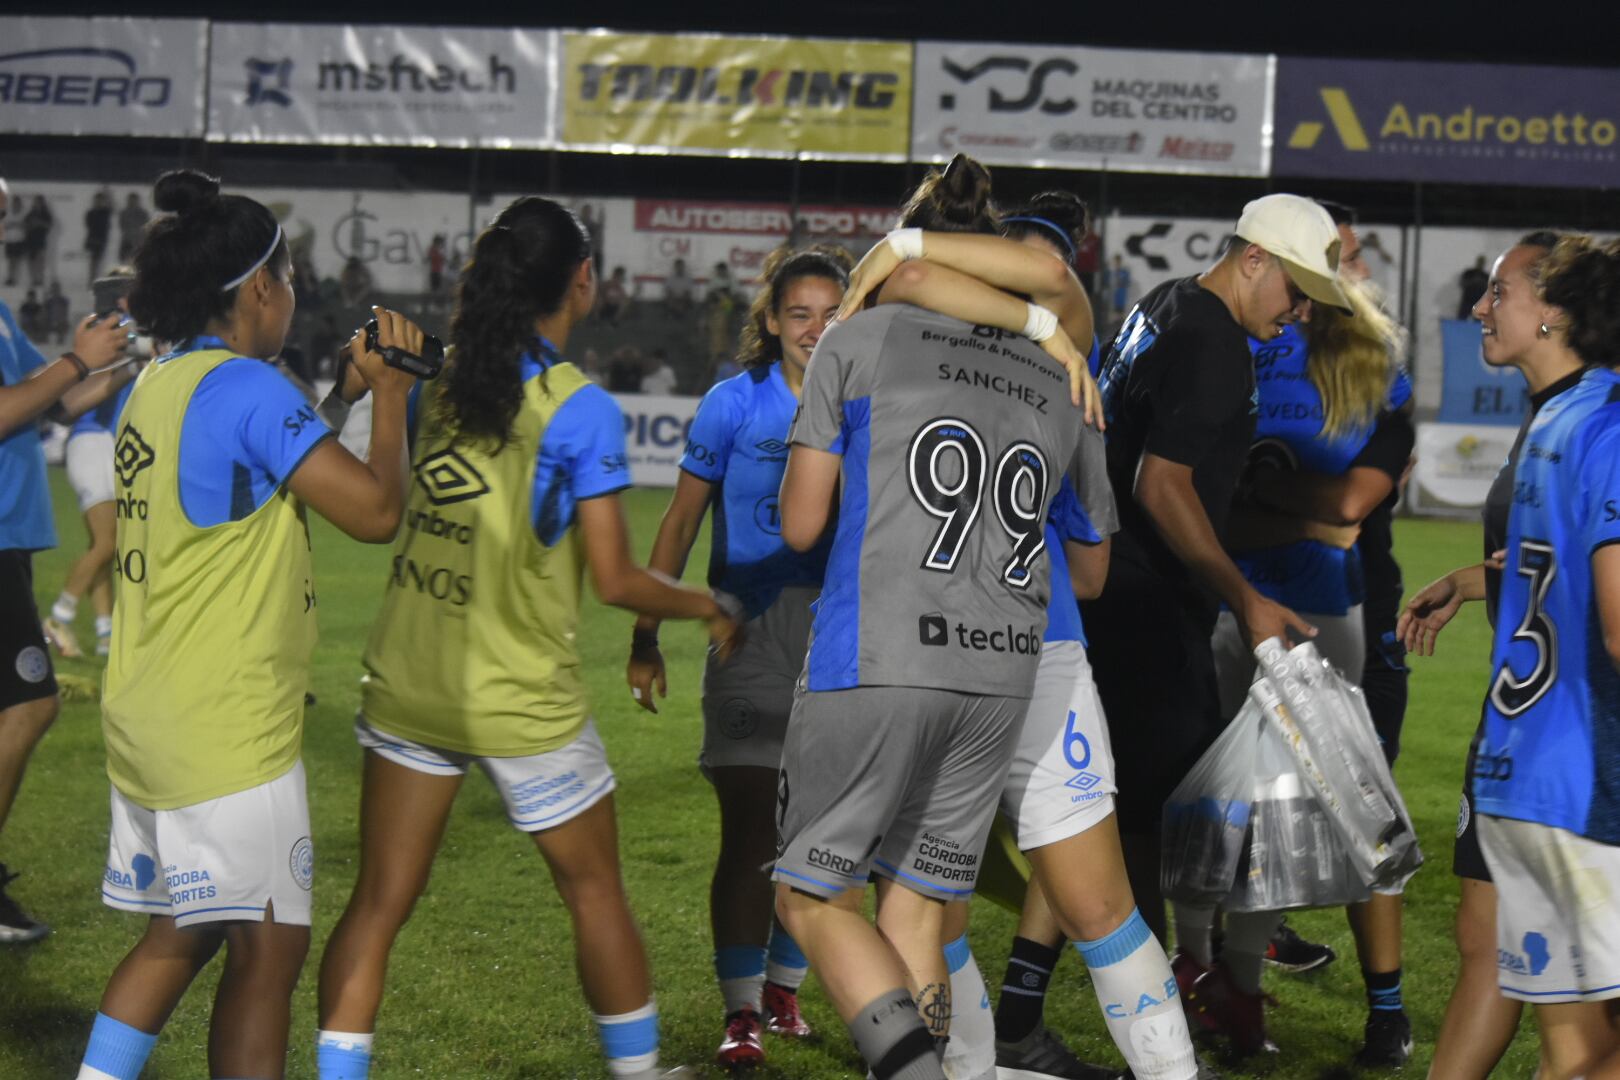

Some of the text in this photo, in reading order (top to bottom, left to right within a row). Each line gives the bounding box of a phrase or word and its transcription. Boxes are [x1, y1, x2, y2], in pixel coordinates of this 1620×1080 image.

[1091, 79, 1220, 101] MAQUINAS
[1091, 100, 1238, 124] DEL CENTRO
[1380, 103, 1617, 146] Androetto
[921, 330, 1063, 383] Bergallo & Pastrone
[938, 363, 1049, 415] SANCHEZ
[906, 416, 1048, 590] 99
[1604, 499, 1620, 523] S
[954, 623, 1040, 656] teclab
[1490, 540, 1559, 719] 3
[1063, 710, 1090, 770] 6
[1071, 791, 1103, 803] umbro
[918, 842, 977, 866] CÓRDOBA
[921, 832, 960, 850] Agencia
[913, 857, 975, 882] DEPORTES
